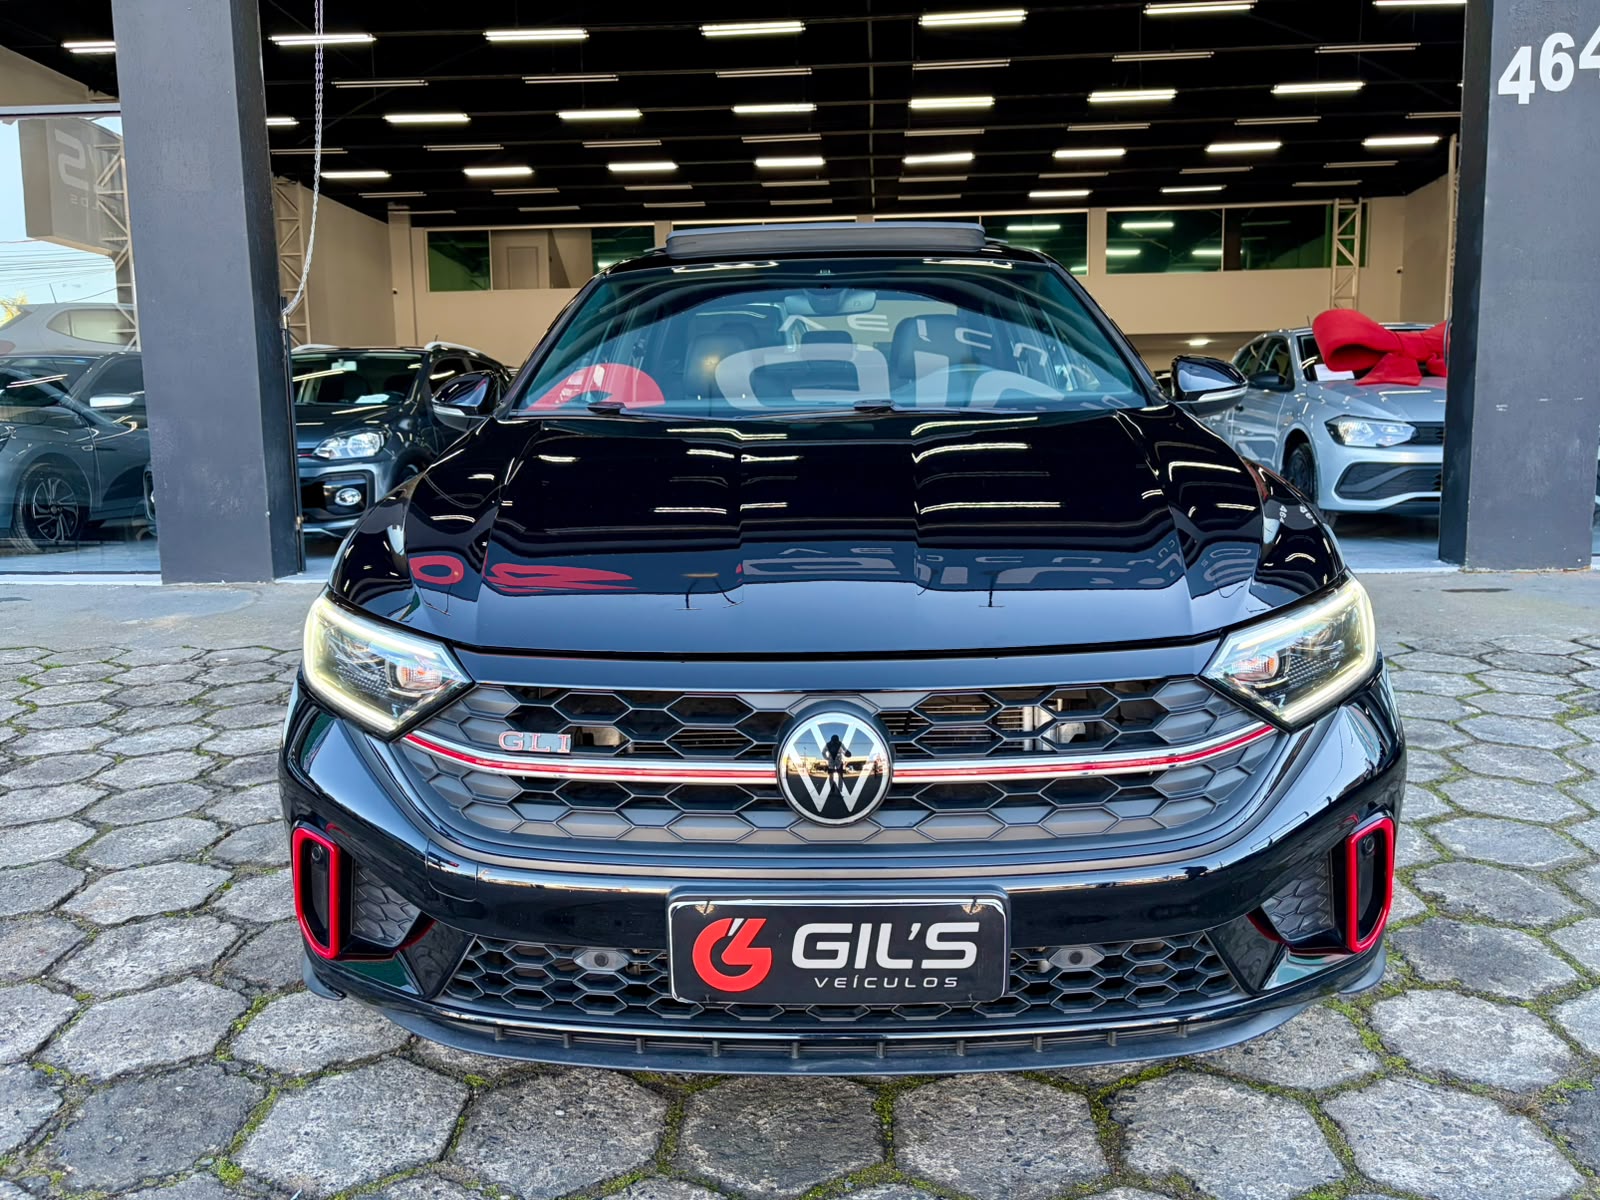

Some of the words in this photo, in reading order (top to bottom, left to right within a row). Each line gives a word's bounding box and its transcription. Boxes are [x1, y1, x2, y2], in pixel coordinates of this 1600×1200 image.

[498, 730, 572, 753] GLI
[791, 921, 980, 970] GIL'S
[813, 974, 959, 989] VEÍCULOS
